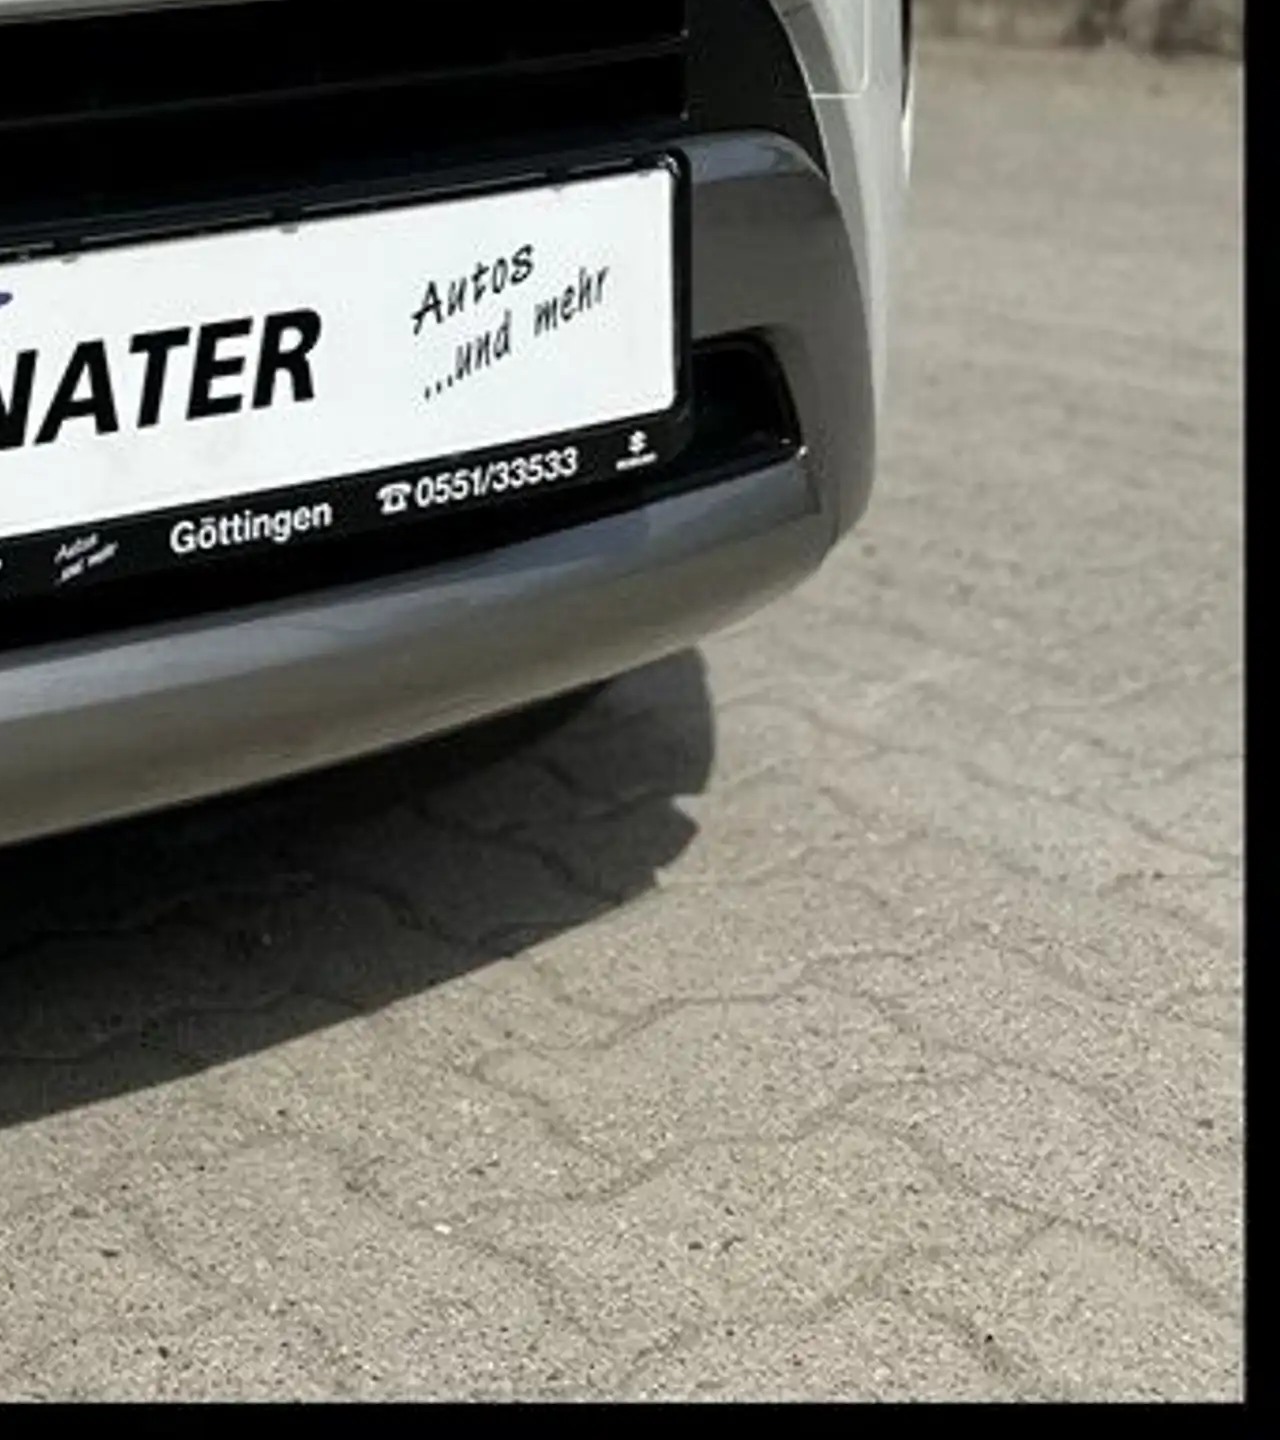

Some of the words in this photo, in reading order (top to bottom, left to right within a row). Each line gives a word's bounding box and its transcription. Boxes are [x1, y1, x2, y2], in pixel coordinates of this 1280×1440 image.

[411, 243, 534, 336] Autos
[532, 265, 610, 338] mehr
[414, 446, 579, 509] 0551/33533
[169, 502, 333, 555] Göttingen
